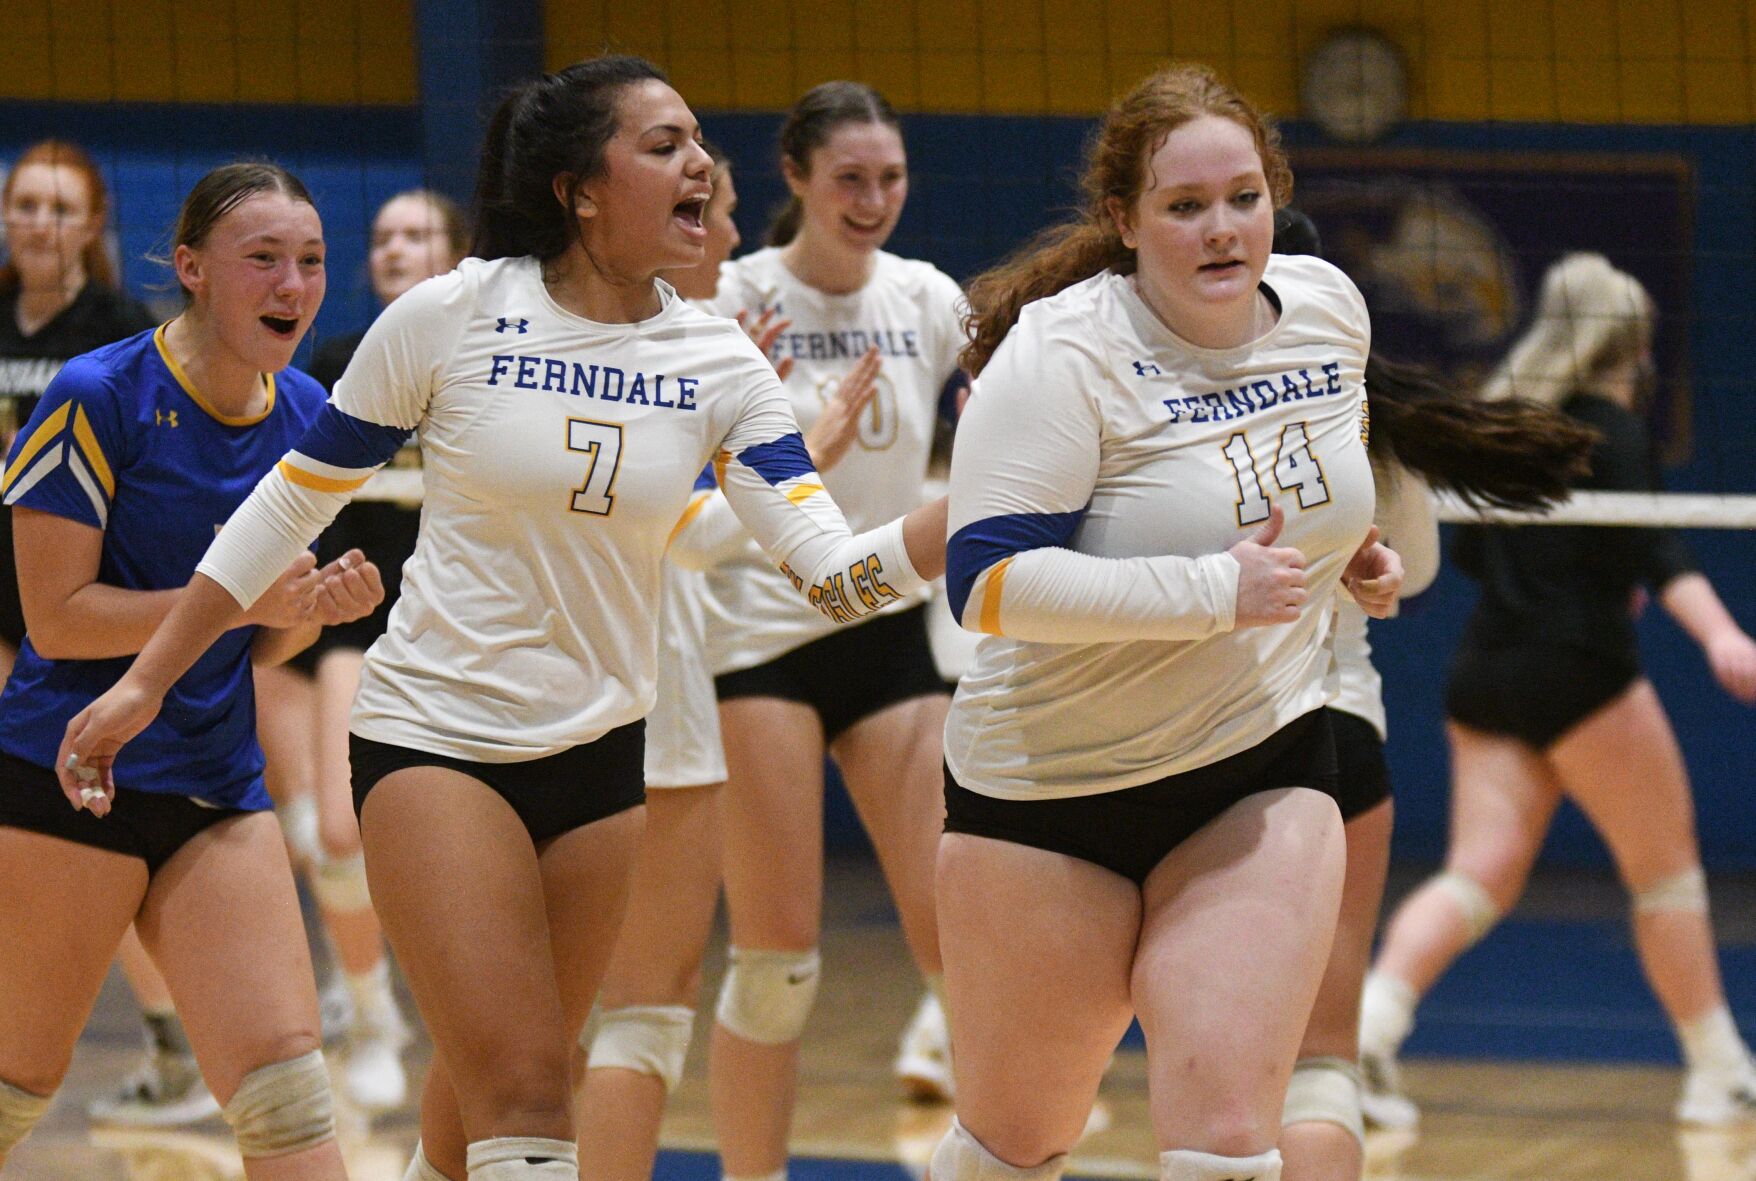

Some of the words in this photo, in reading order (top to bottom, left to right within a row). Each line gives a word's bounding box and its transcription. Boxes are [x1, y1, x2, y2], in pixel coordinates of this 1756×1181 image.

[487, 355, 699, 411] FERNDALE
[1163, 361, 1342, 424] FERNDALE
[564, 415, 625, 517] 7
[1219, 419, 1332, 529] 14
